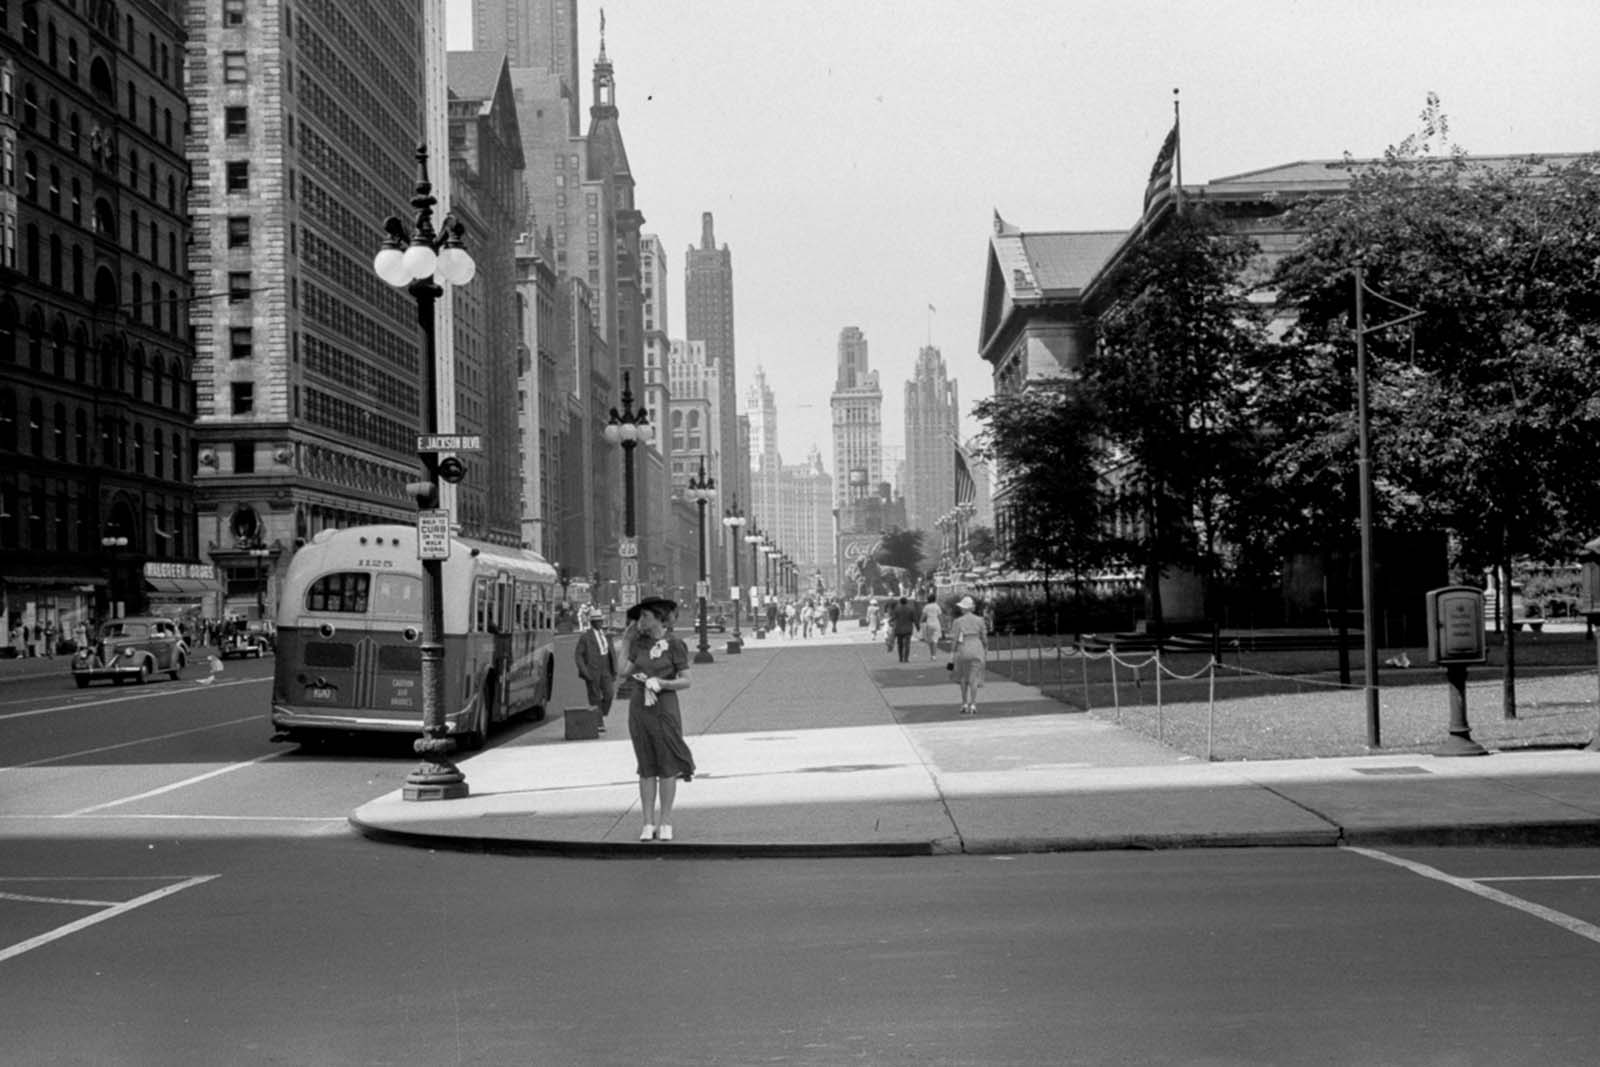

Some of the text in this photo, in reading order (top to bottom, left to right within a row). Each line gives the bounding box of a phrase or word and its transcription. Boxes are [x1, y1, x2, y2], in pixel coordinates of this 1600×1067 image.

[417, 436, 424, 449] E
[426, 436, 461, 449] JACKSON
[421, 525, 446, 533] CURB
